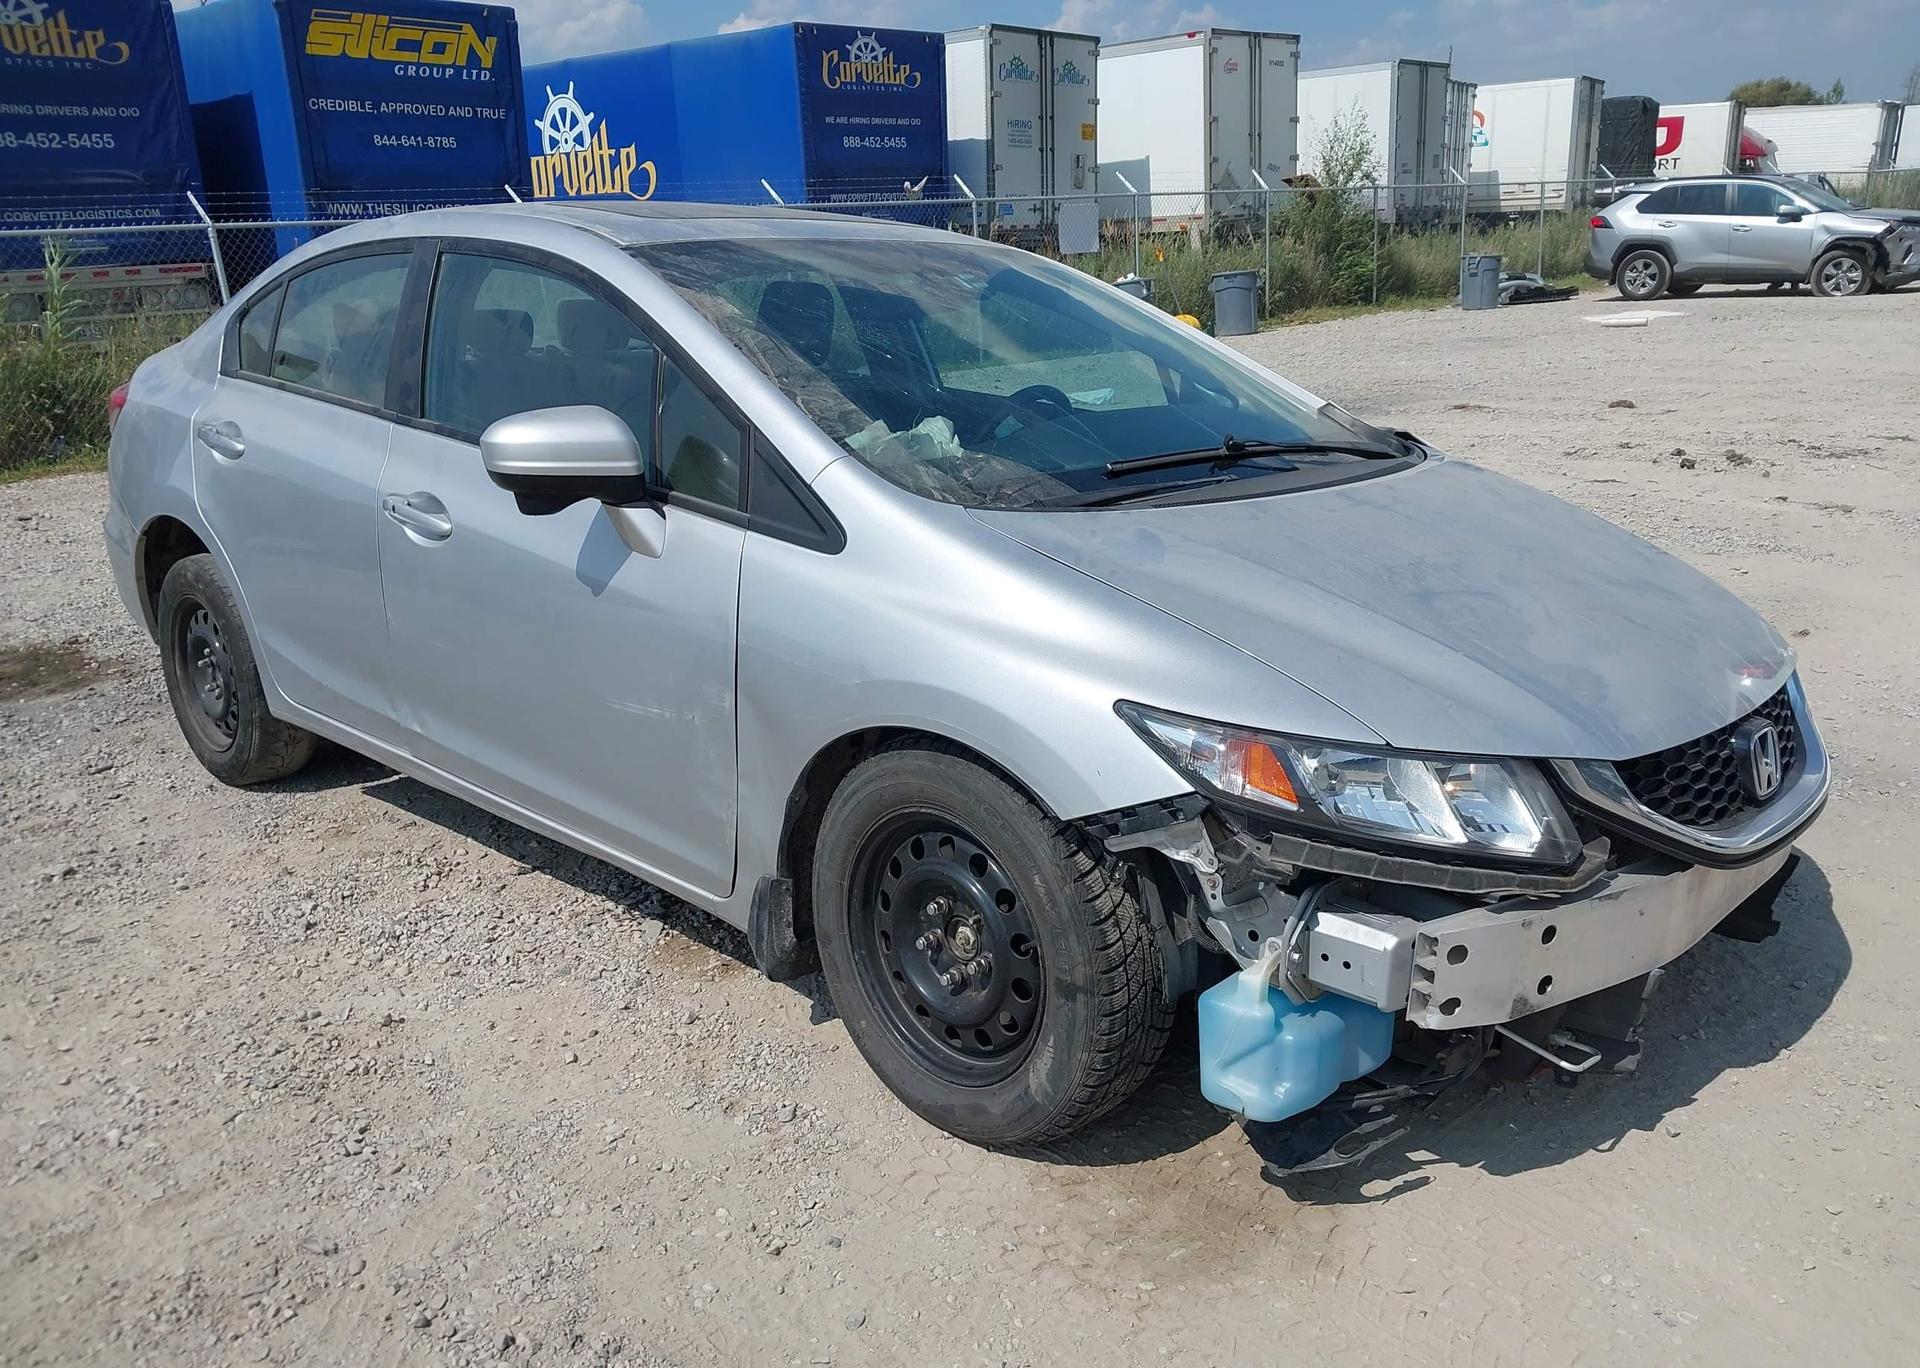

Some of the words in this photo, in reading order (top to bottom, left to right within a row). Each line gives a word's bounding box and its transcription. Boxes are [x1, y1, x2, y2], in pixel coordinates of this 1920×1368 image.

[394, 65, 455, 79] GROUP
[462, 69, 496, 82] LTD.
[822, 49, 921, 89] Corvette
[999, 62, 1039, 83] Corvette
[36, 105, 89, 116] DRIVERS
[91, 108, 117, 117] AND
[309, 98, 377, 114] CREDIBLE,
[380, 102, 446, 116] APPROVED
[448, 106, 473, 118] AND
[475, 107, 507, 119] TRUE
[825, 116, 836, 124] WE
[836, 116, 849, 124] ARE
[849, 117, 871, 125] HIRING
[1007, 119, 1033, 131] HIRING
[373, 134, 457, 149] 844-641-8785
[843, 136, 907, 149] 888-452-5455
